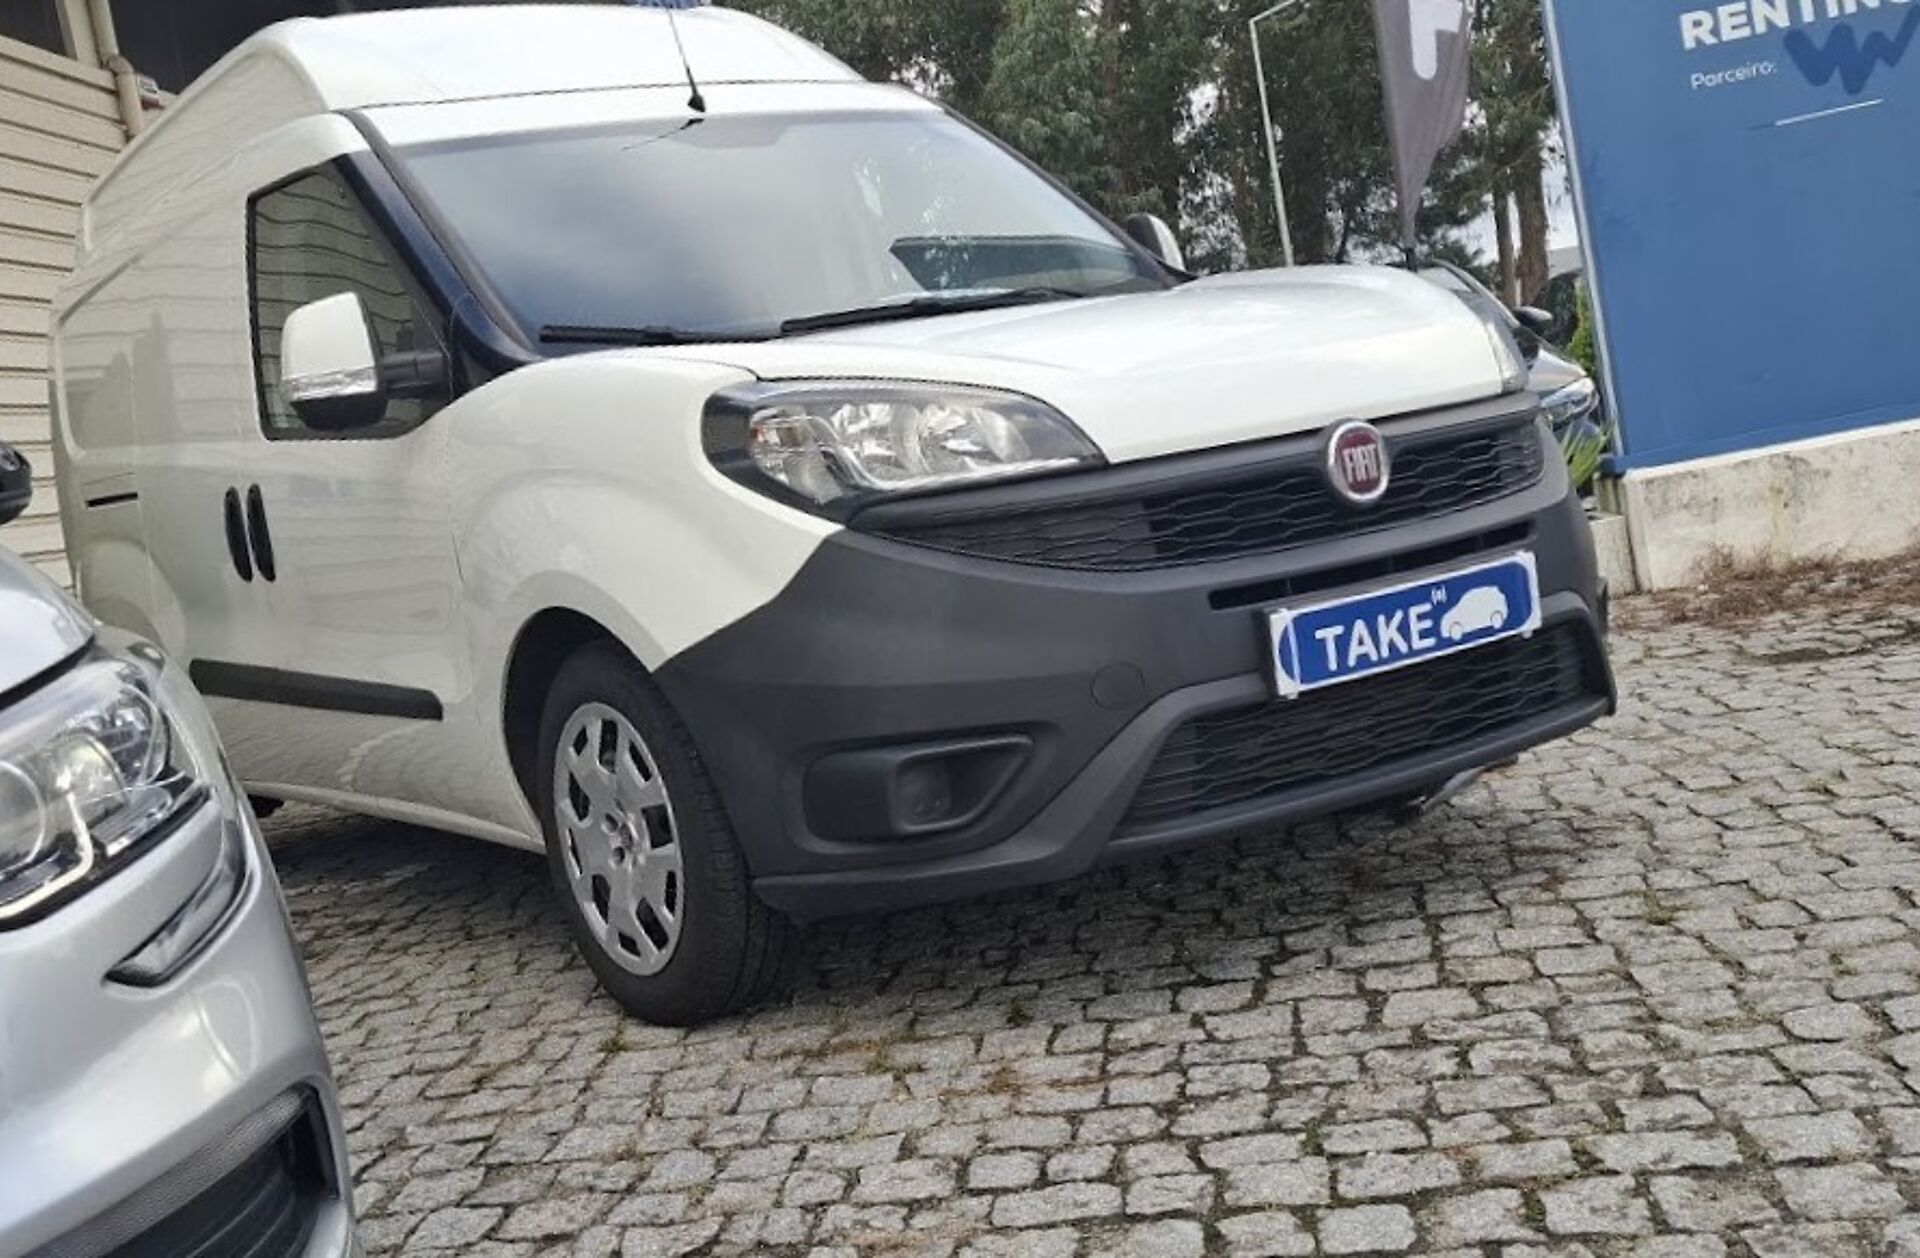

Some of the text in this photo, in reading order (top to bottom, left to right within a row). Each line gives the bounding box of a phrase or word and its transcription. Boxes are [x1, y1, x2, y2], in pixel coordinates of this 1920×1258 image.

[1679, 0, 1911, 49] RENT
[1690, 61, 1777, 90] Parceiro:
[1342, 443, 1379, 482] FIAT
[1315, 602, 1437, 671] TAKE
